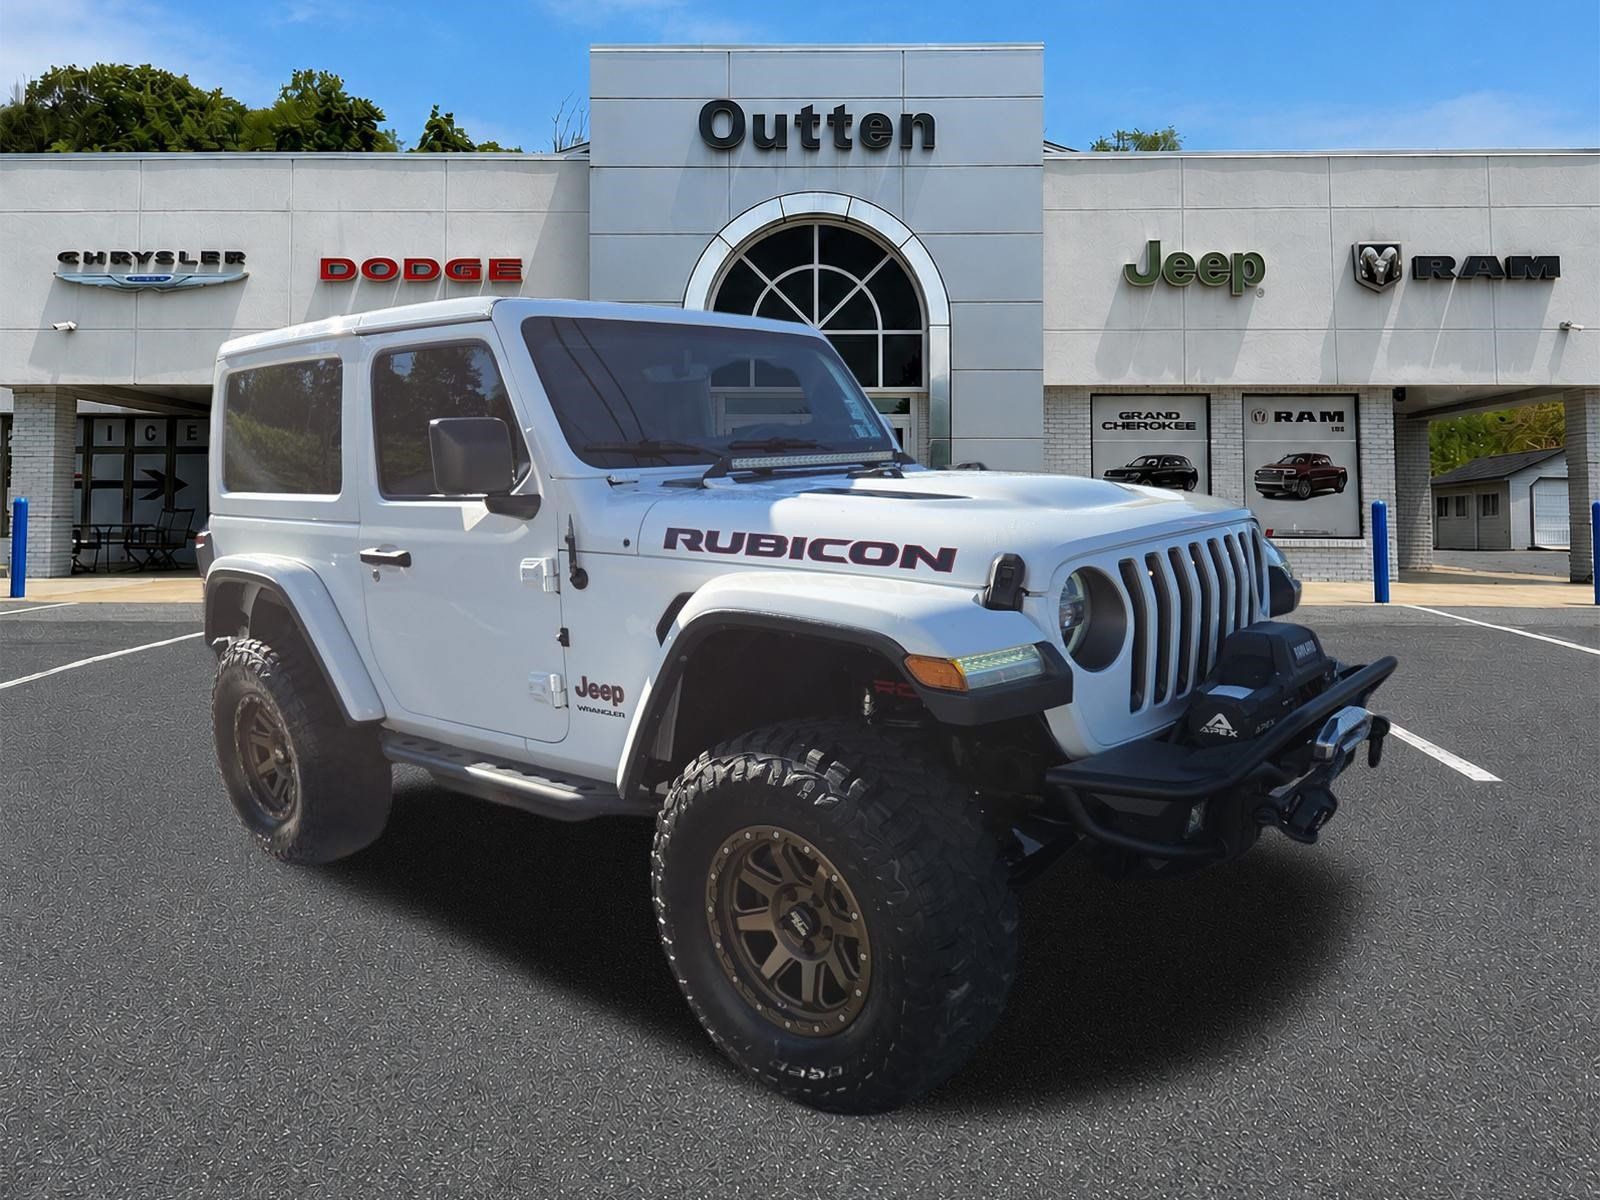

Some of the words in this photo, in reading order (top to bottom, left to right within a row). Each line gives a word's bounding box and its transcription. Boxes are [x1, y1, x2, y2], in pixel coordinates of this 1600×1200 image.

[699, 99, 936, 149] Outten
[57, 251, 246, 265] CHRYSLER
[1123, 240, 1266, 296] Jeep
[1411, 255, 1561, 280] RAM
[320, 257, 523, 283] DODGE
[1118, 411, 1181, 420] GRAND
[1274, 411, 1345, 423] RAM
[1101, 421, 1197, 431] CHEROKEE
[663, 527, 958, 573] RUBICON
[575, 675, 625, 707] Jeep
[577, 704, 626, 719] WRANGLER
[1199, 726, 1238, 738] APEX
